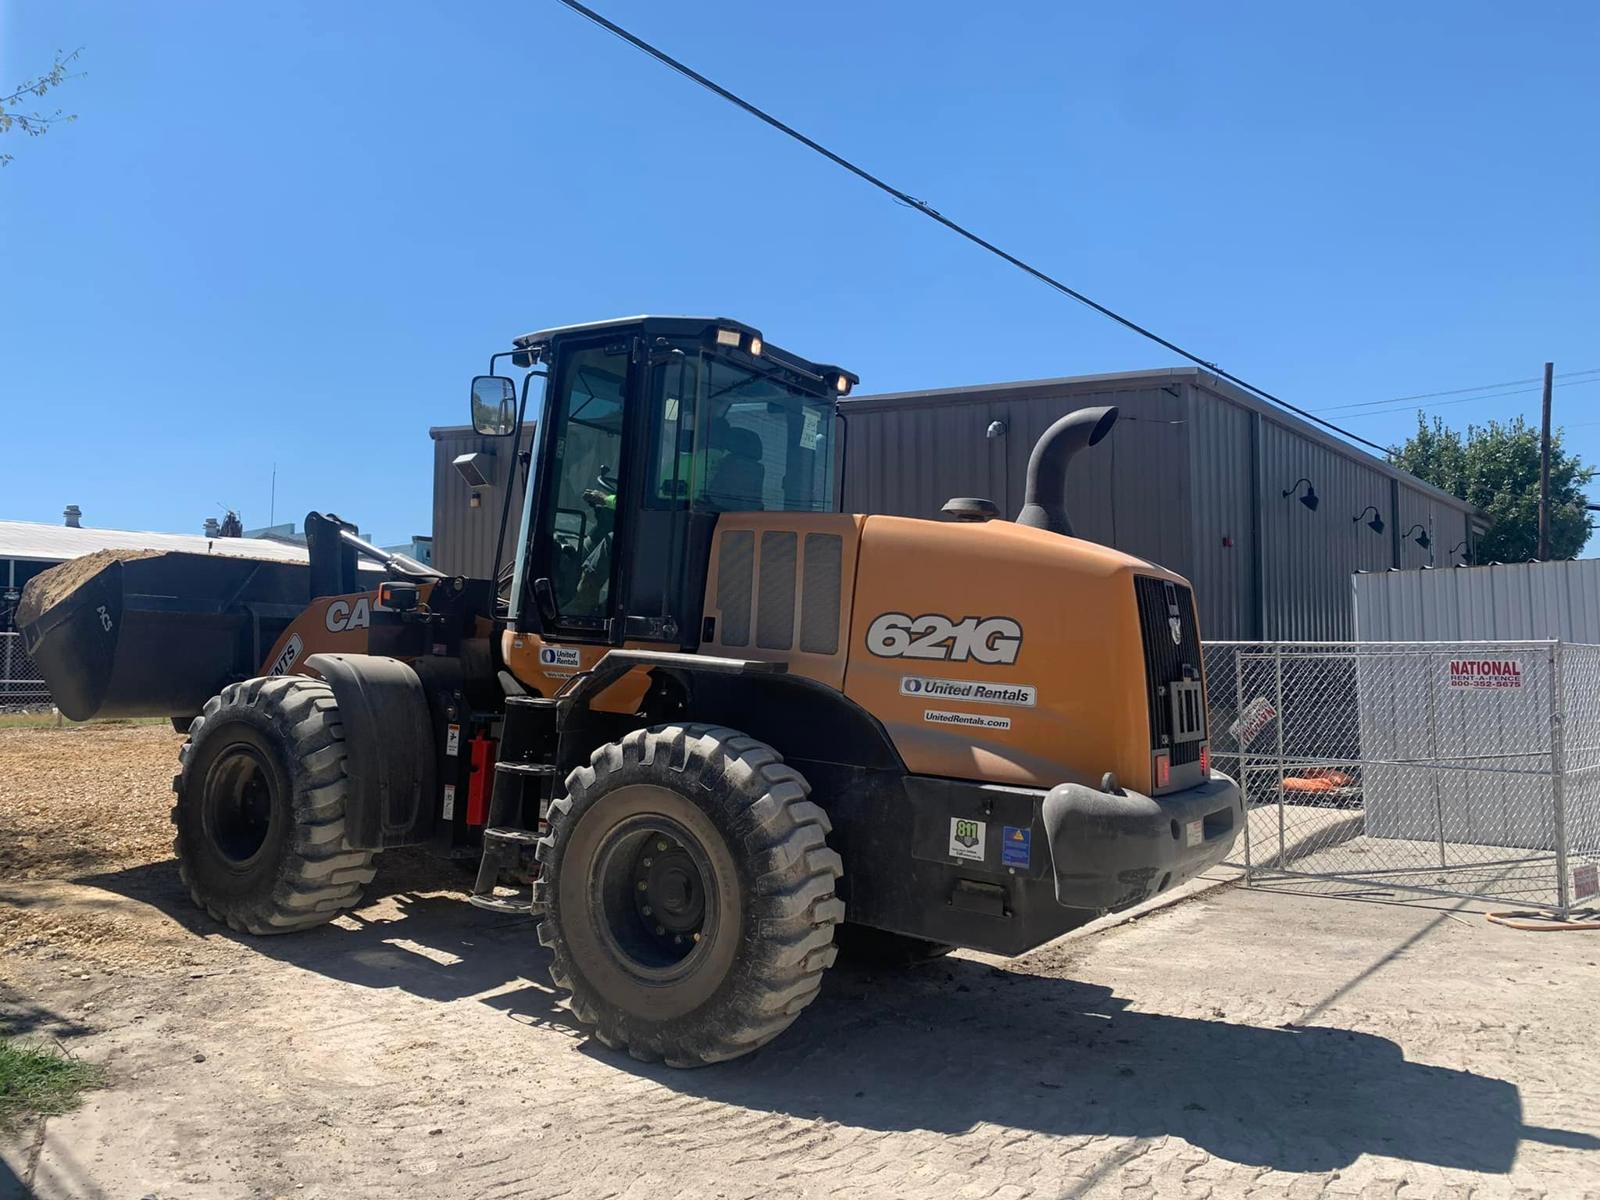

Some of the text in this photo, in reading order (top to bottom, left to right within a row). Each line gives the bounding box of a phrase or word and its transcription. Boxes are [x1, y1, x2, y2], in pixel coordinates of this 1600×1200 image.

[865, 612, 1024, 665] 621G
[556, 650, 577, 659] United
[556, 657, 579, 666] Rentals
[1450, 661, 1521, 676] NATIONAL
[924, 681, 1029, 702] United Rentals
[925, 712, 1009, 728] UnitedRentals.com
[956, 820, 979, 841] 811
